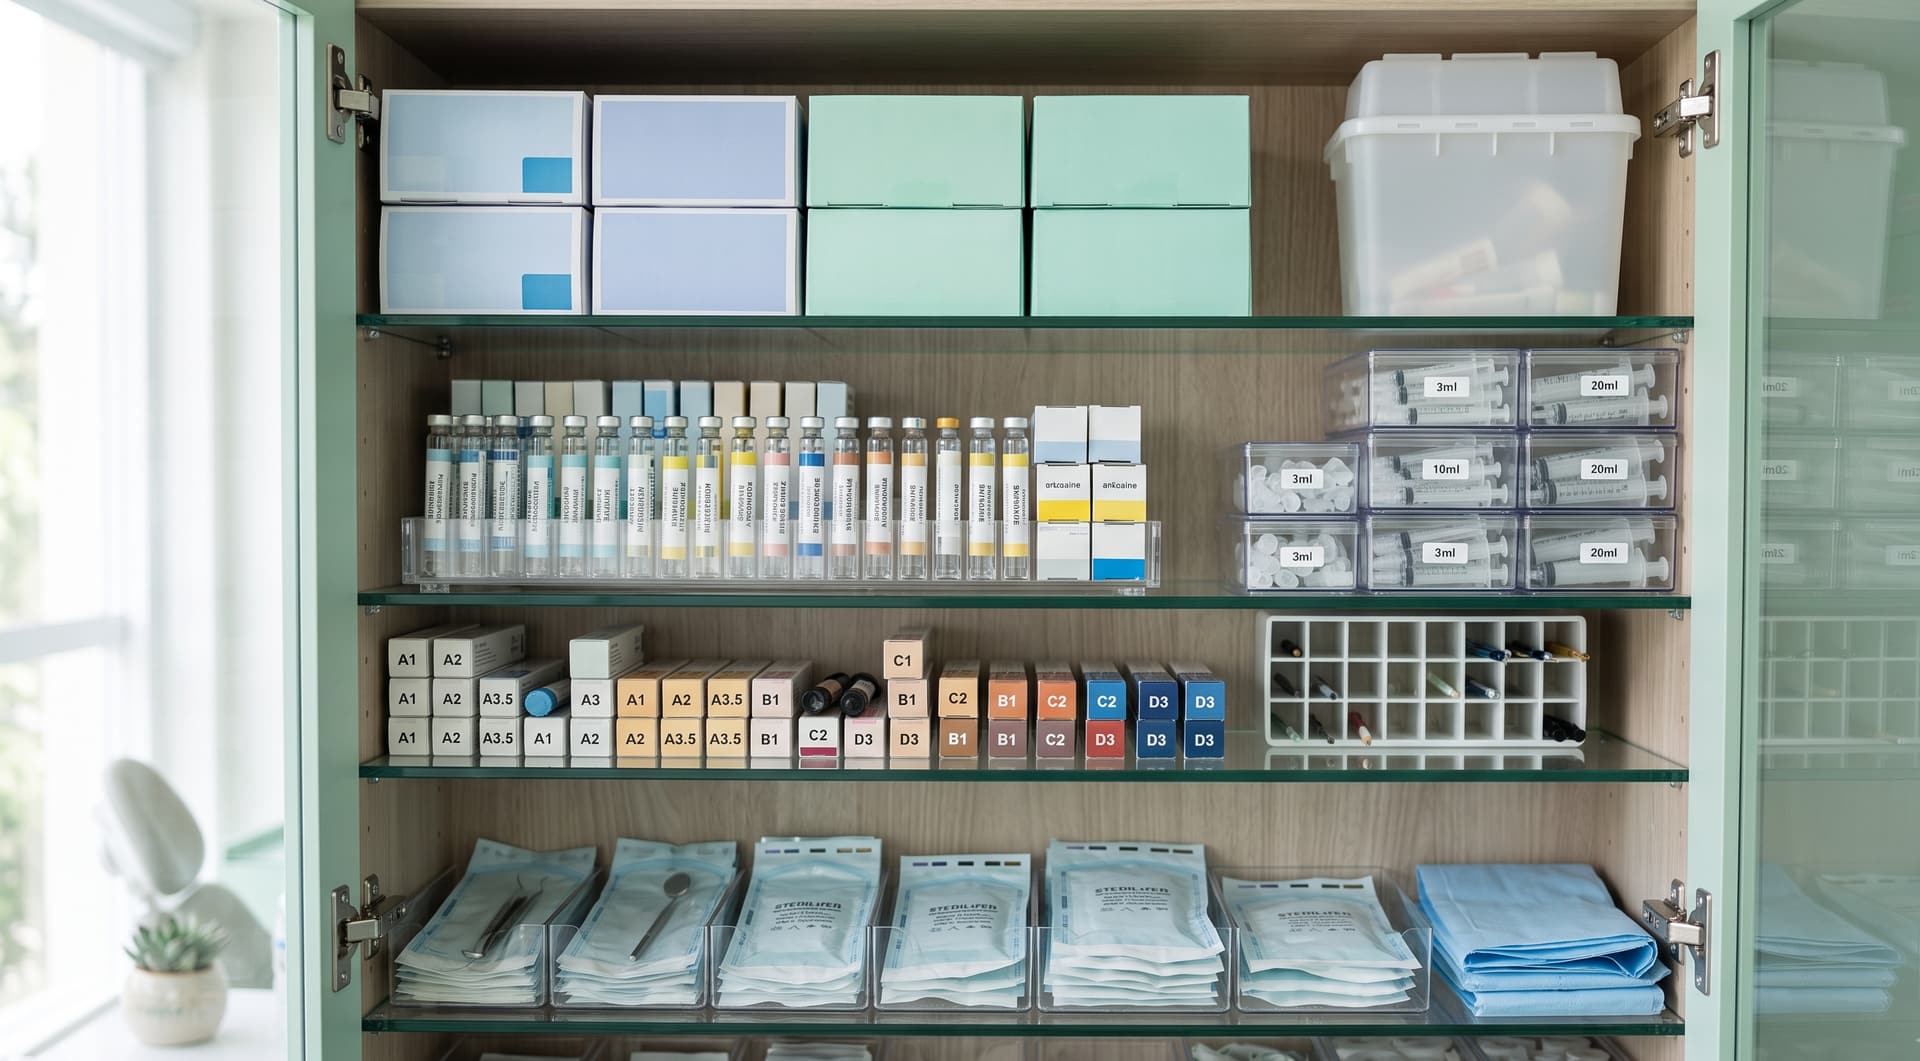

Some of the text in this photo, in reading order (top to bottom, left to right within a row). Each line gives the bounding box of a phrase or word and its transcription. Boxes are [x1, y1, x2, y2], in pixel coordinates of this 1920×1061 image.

[1436, 381, 1457, 392] 3ml
[1591, 380, 1618, 391] 20ml
[1433, 464, 1460, 474] 10ml
[1591, 463, 1618, 474] 20ml
[1292, 473, 1313, 484] 3ml
[1292, 551, 1313, 562] 3ml
[1434, 547, 1456, 558] 3ml
[1590, 547, 1618, 558] 20ml
[397, 653, 416, 666] A1
[442, 653, 462, 666] A2
[893, 654, 911, 667] C1
[398, 692, 416, 705] A1
[442, 693, 462, 705] A2
[482, 692, 513, 705] A3.5
[580, 693, 600, 706] A3
[626, 693, 644, 706] A1
[671, 694, 691, 706] A2
[711, 693, 743, 706] A3.5
[762, 693, 779, 706] B1
[898, 693, 916, 706] B1
[948, 692, 968, 705] C2
[997, 694, 1016, 708] B1
[1047, 695, 1067, 708] C2
[1097, 695, 1117, 708] C2
[1149, 695, 1169, 709] D3
[1195, 695, 1215, 709] D3
[398, 731, 416, 744] A1
[441, 731, 461, 744] A2
[482, 732, 514, 744] A3.5
[533, 732, 551, 745] A1
[580, 733, 600, 745] A2
[625, 733, 645, 745] A2
[664, 732, 696, 745] A3.5
[709, 732, 742, 745] A3.5
[761, 733, 778, 746] B1
[809, 729, 828, 741] C2
[854, 733, 873, 746] D3
[900, 733, 919, 746] D3
[948, 732, 967, 745] B1
[997, 733, 1016, 746] B1
[1045, 733, 1065, 746] C2
[1095, 733, 1115, 746] D3
[1147, 733, 1167, 747] D3
[1194, 734, 1215, 747] D3
